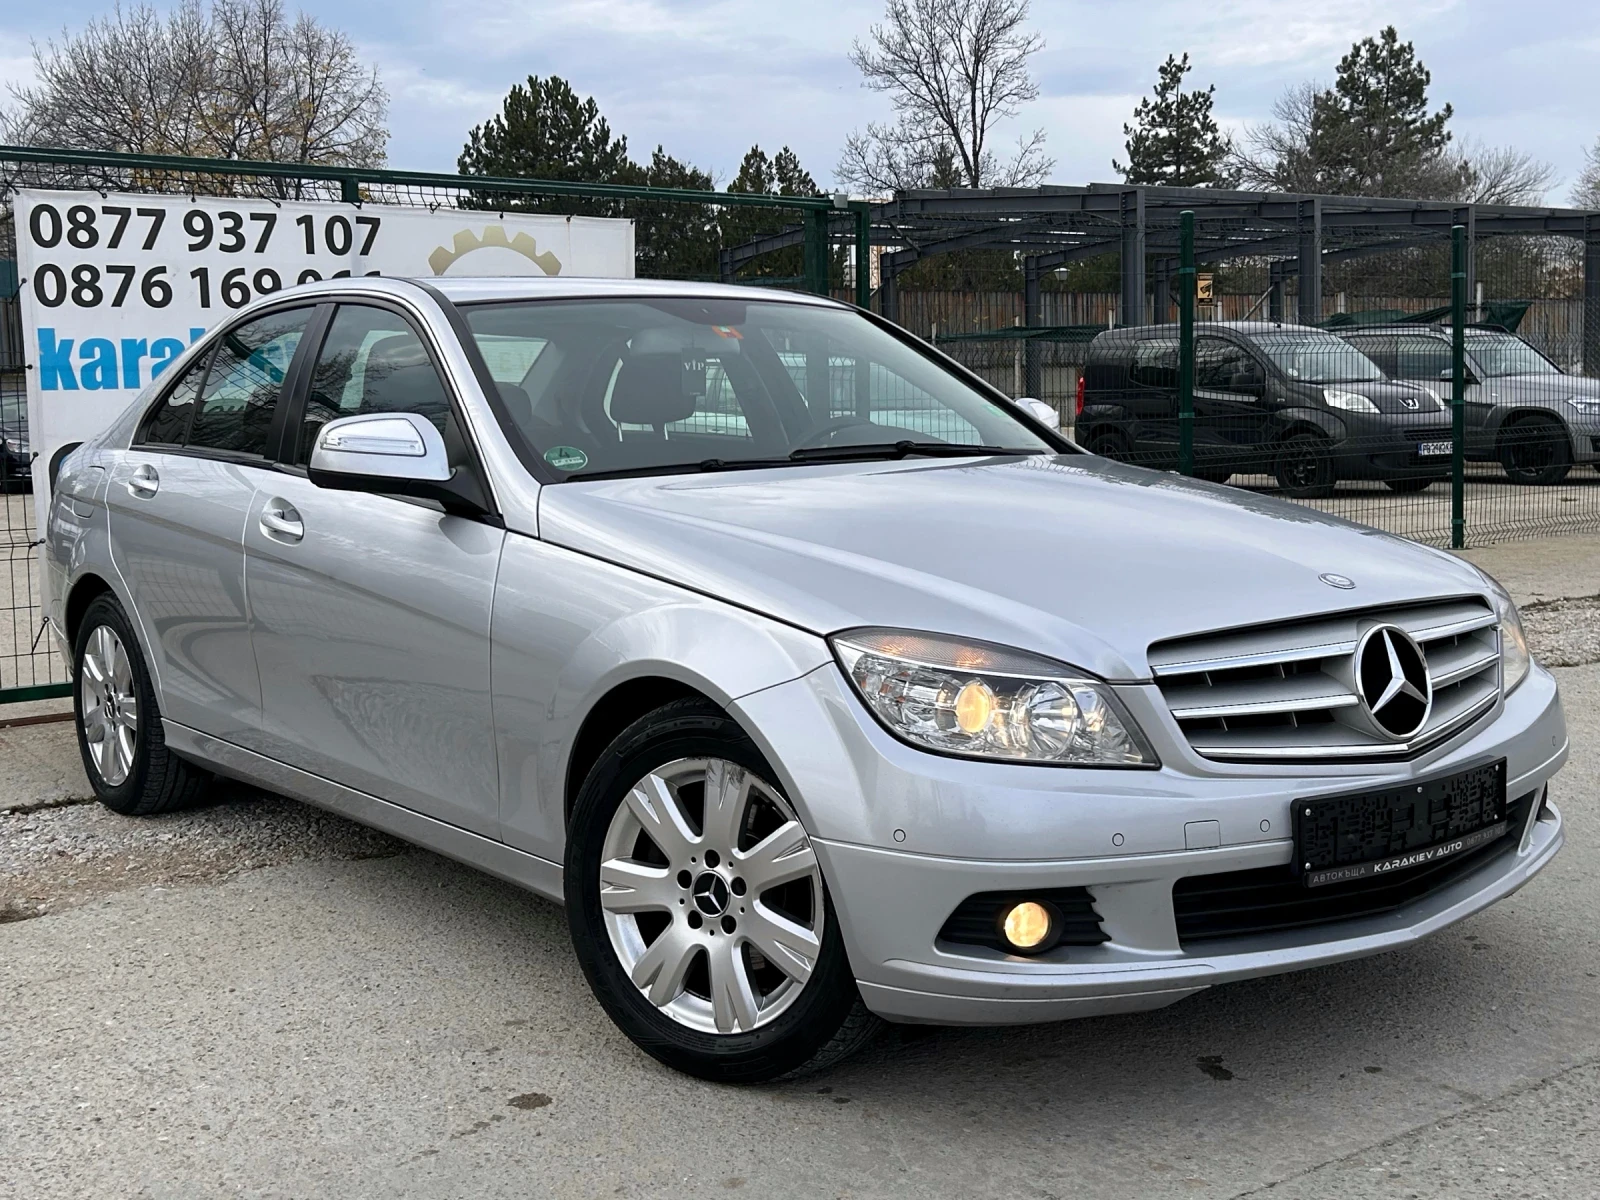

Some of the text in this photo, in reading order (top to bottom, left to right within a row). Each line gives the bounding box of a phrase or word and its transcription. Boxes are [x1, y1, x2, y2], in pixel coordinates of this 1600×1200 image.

[29, 203, 381, 256] 0877 937 107
[33, 263, 282, 309] 0876 169
[37, 327, 206, 391] kara
[1313, 867, 1366, 883] АВТОКЪЩА
[1373, 850, 1435, 873] KARAKIEV
[1436, 841, 1463, 857] AUTO
